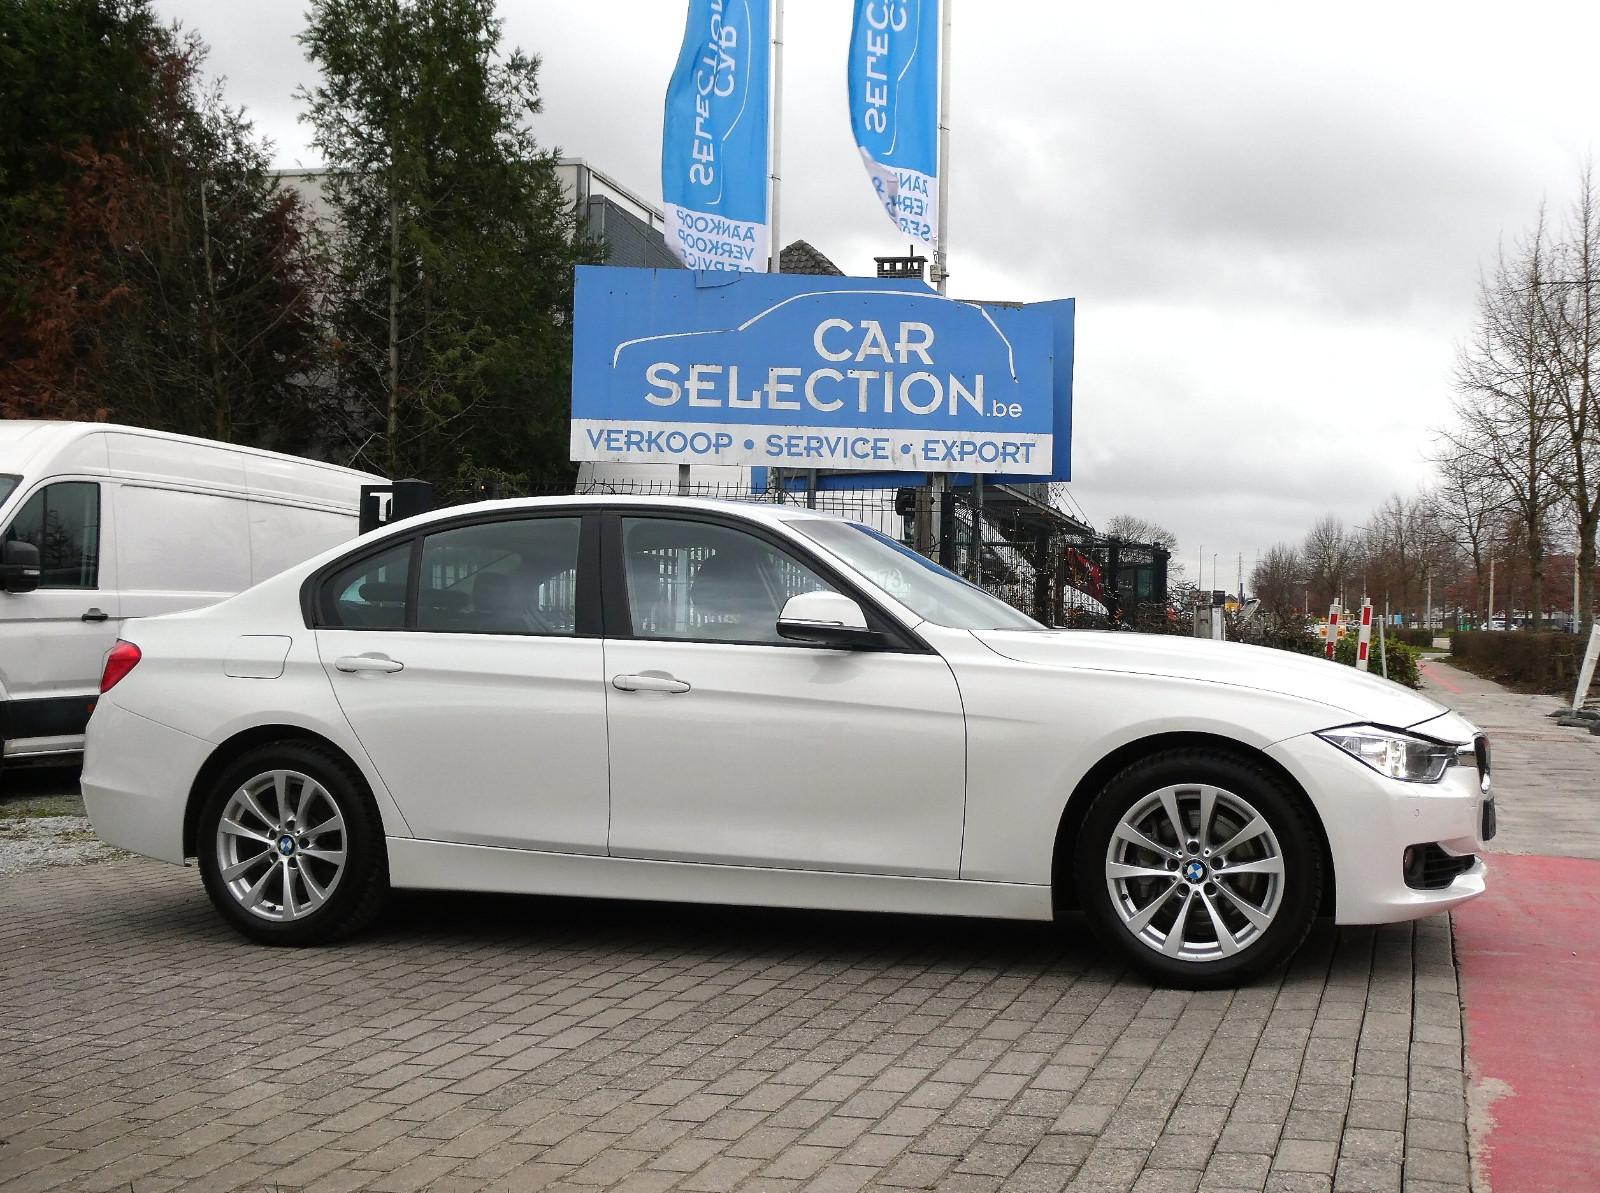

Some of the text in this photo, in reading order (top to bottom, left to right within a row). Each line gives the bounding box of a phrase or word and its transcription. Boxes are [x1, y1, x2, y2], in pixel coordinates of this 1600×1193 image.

[813, 318, 935, 365] CAR
[586, 428, 1036, 464] VERKOOP SERVICE EXPORT
